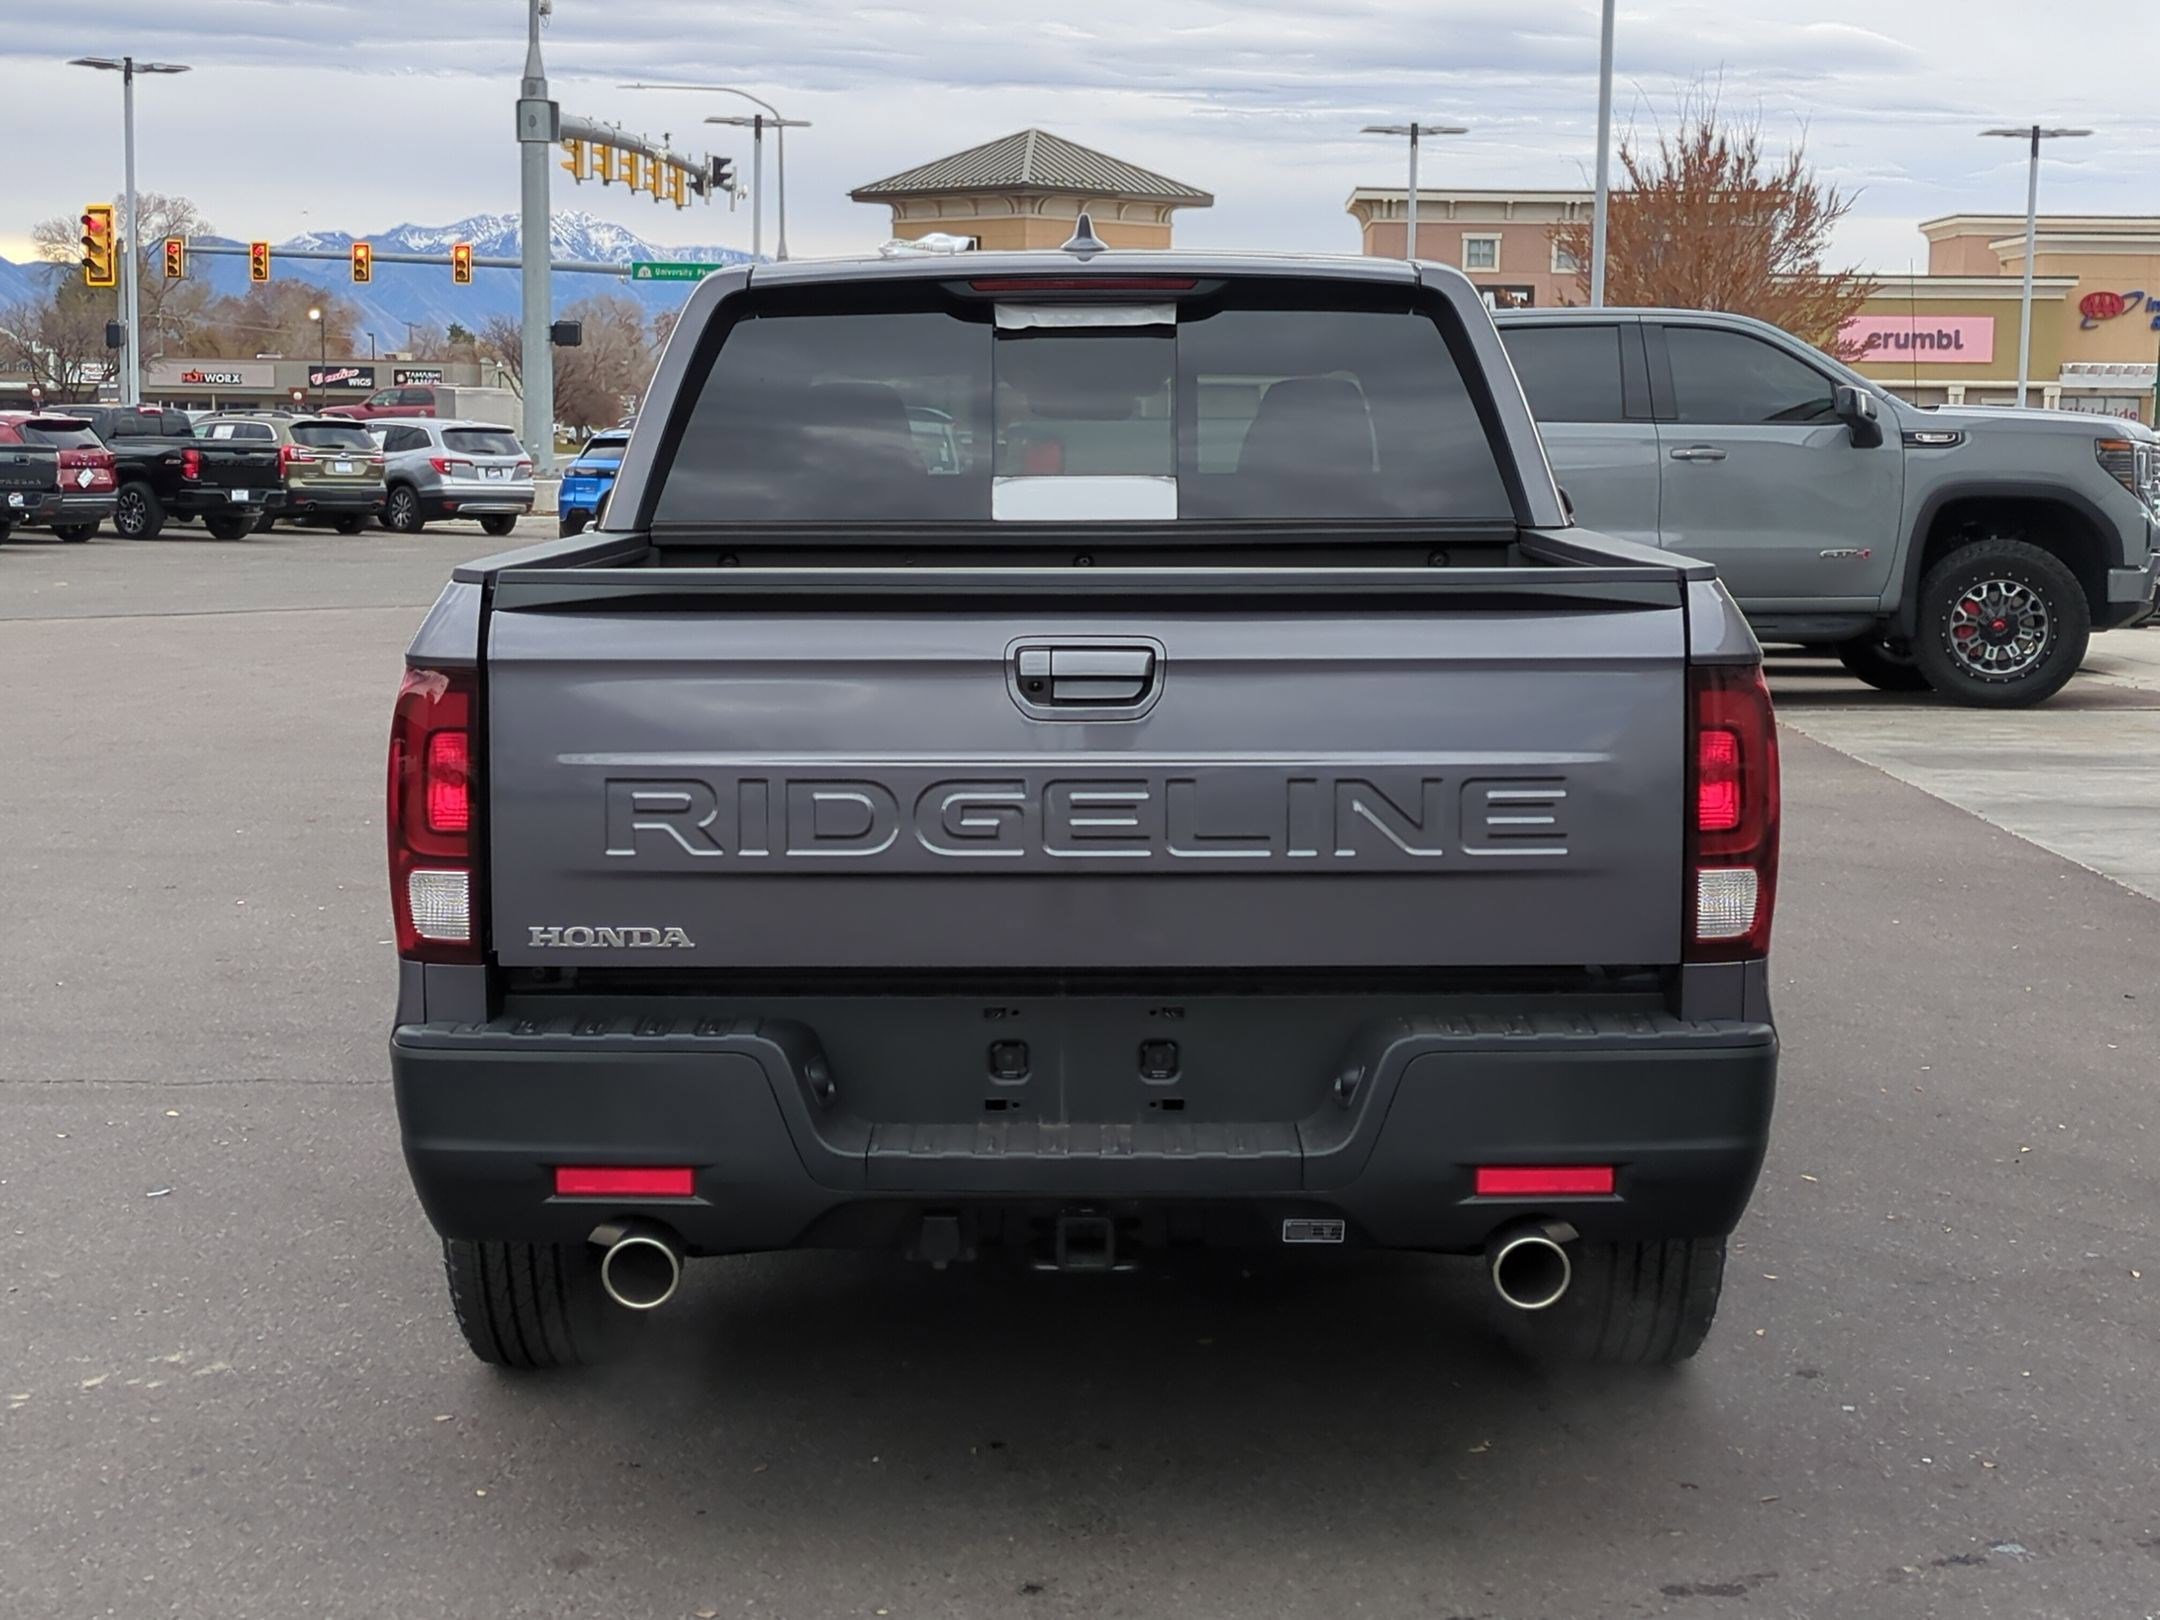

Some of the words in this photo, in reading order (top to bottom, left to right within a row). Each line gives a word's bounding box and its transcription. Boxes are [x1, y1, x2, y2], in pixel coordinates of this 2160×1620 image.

[655, 267, 693, 277] University
[1868, 330, 1964, 350] crumbl
[347, 378, 372, 387] WIGS
[605, 777, 1569, 857] RIDGELINE
[528, 926, 696, 948] HONDA
